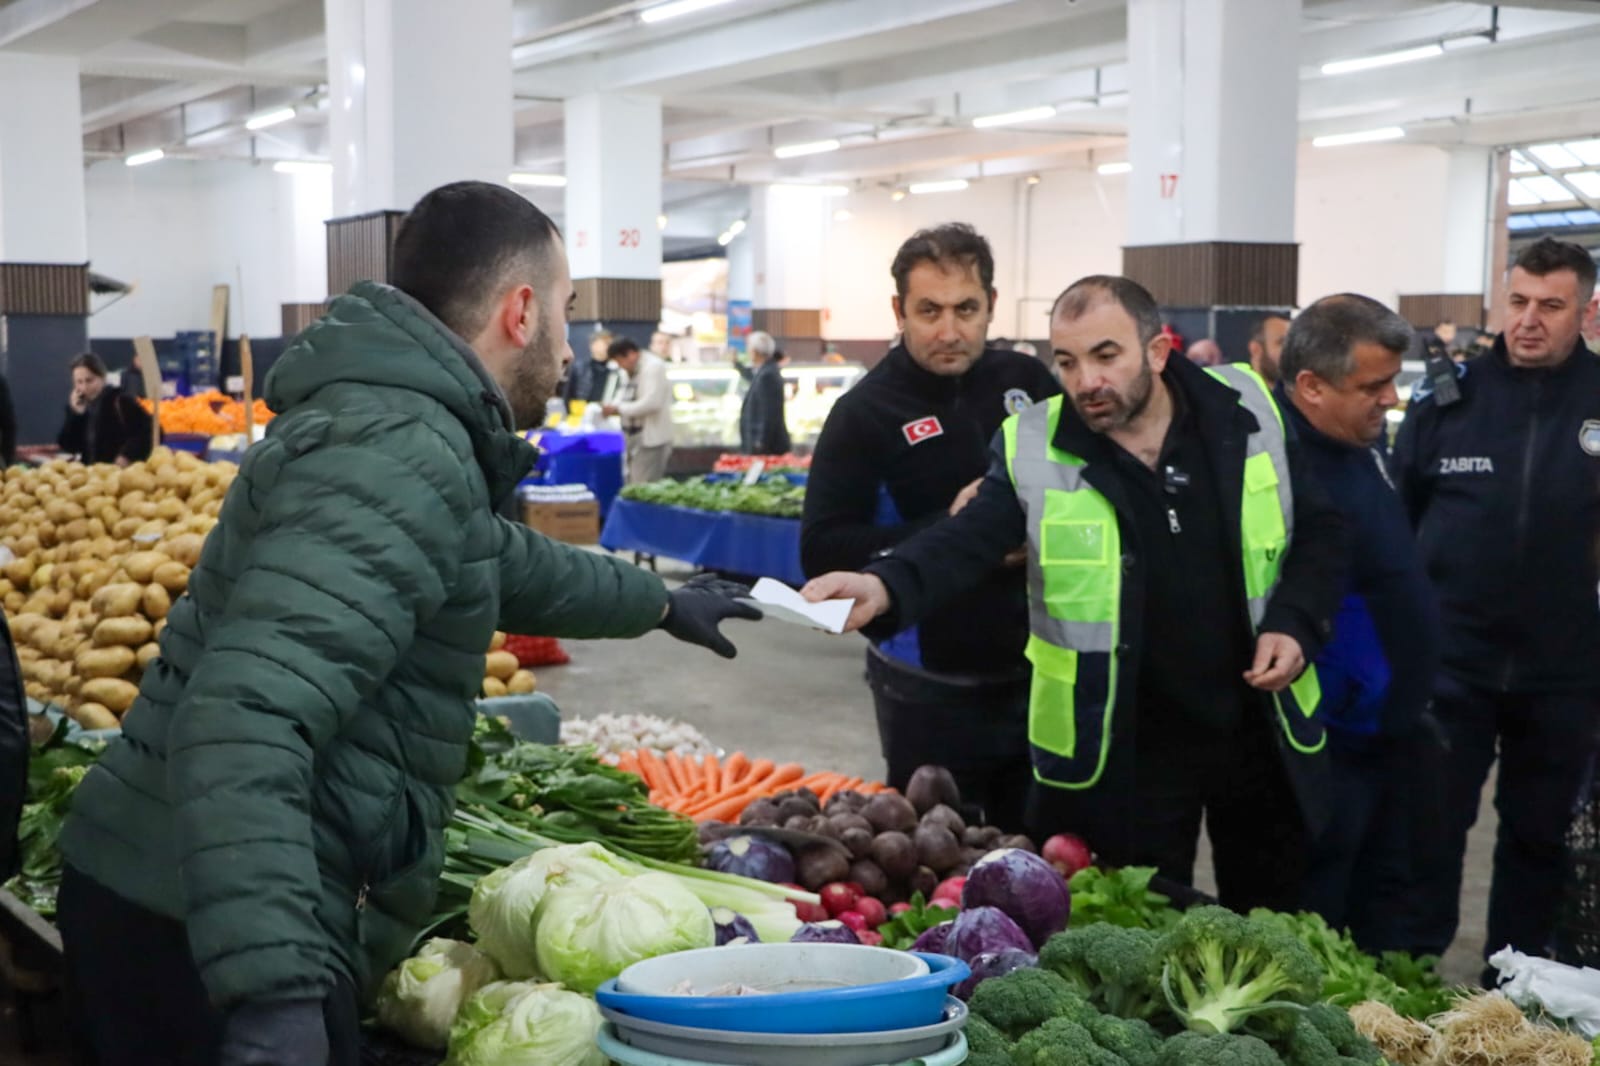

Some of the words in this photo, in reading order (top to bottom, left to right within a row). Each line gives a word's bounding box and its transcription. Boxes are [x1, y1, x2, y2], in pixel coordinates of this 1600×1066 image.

[1159, 174, 1179, 199] 17
[619, 228, 641, 248] 20
[1440, 456, 1494, 474] ZABITA
